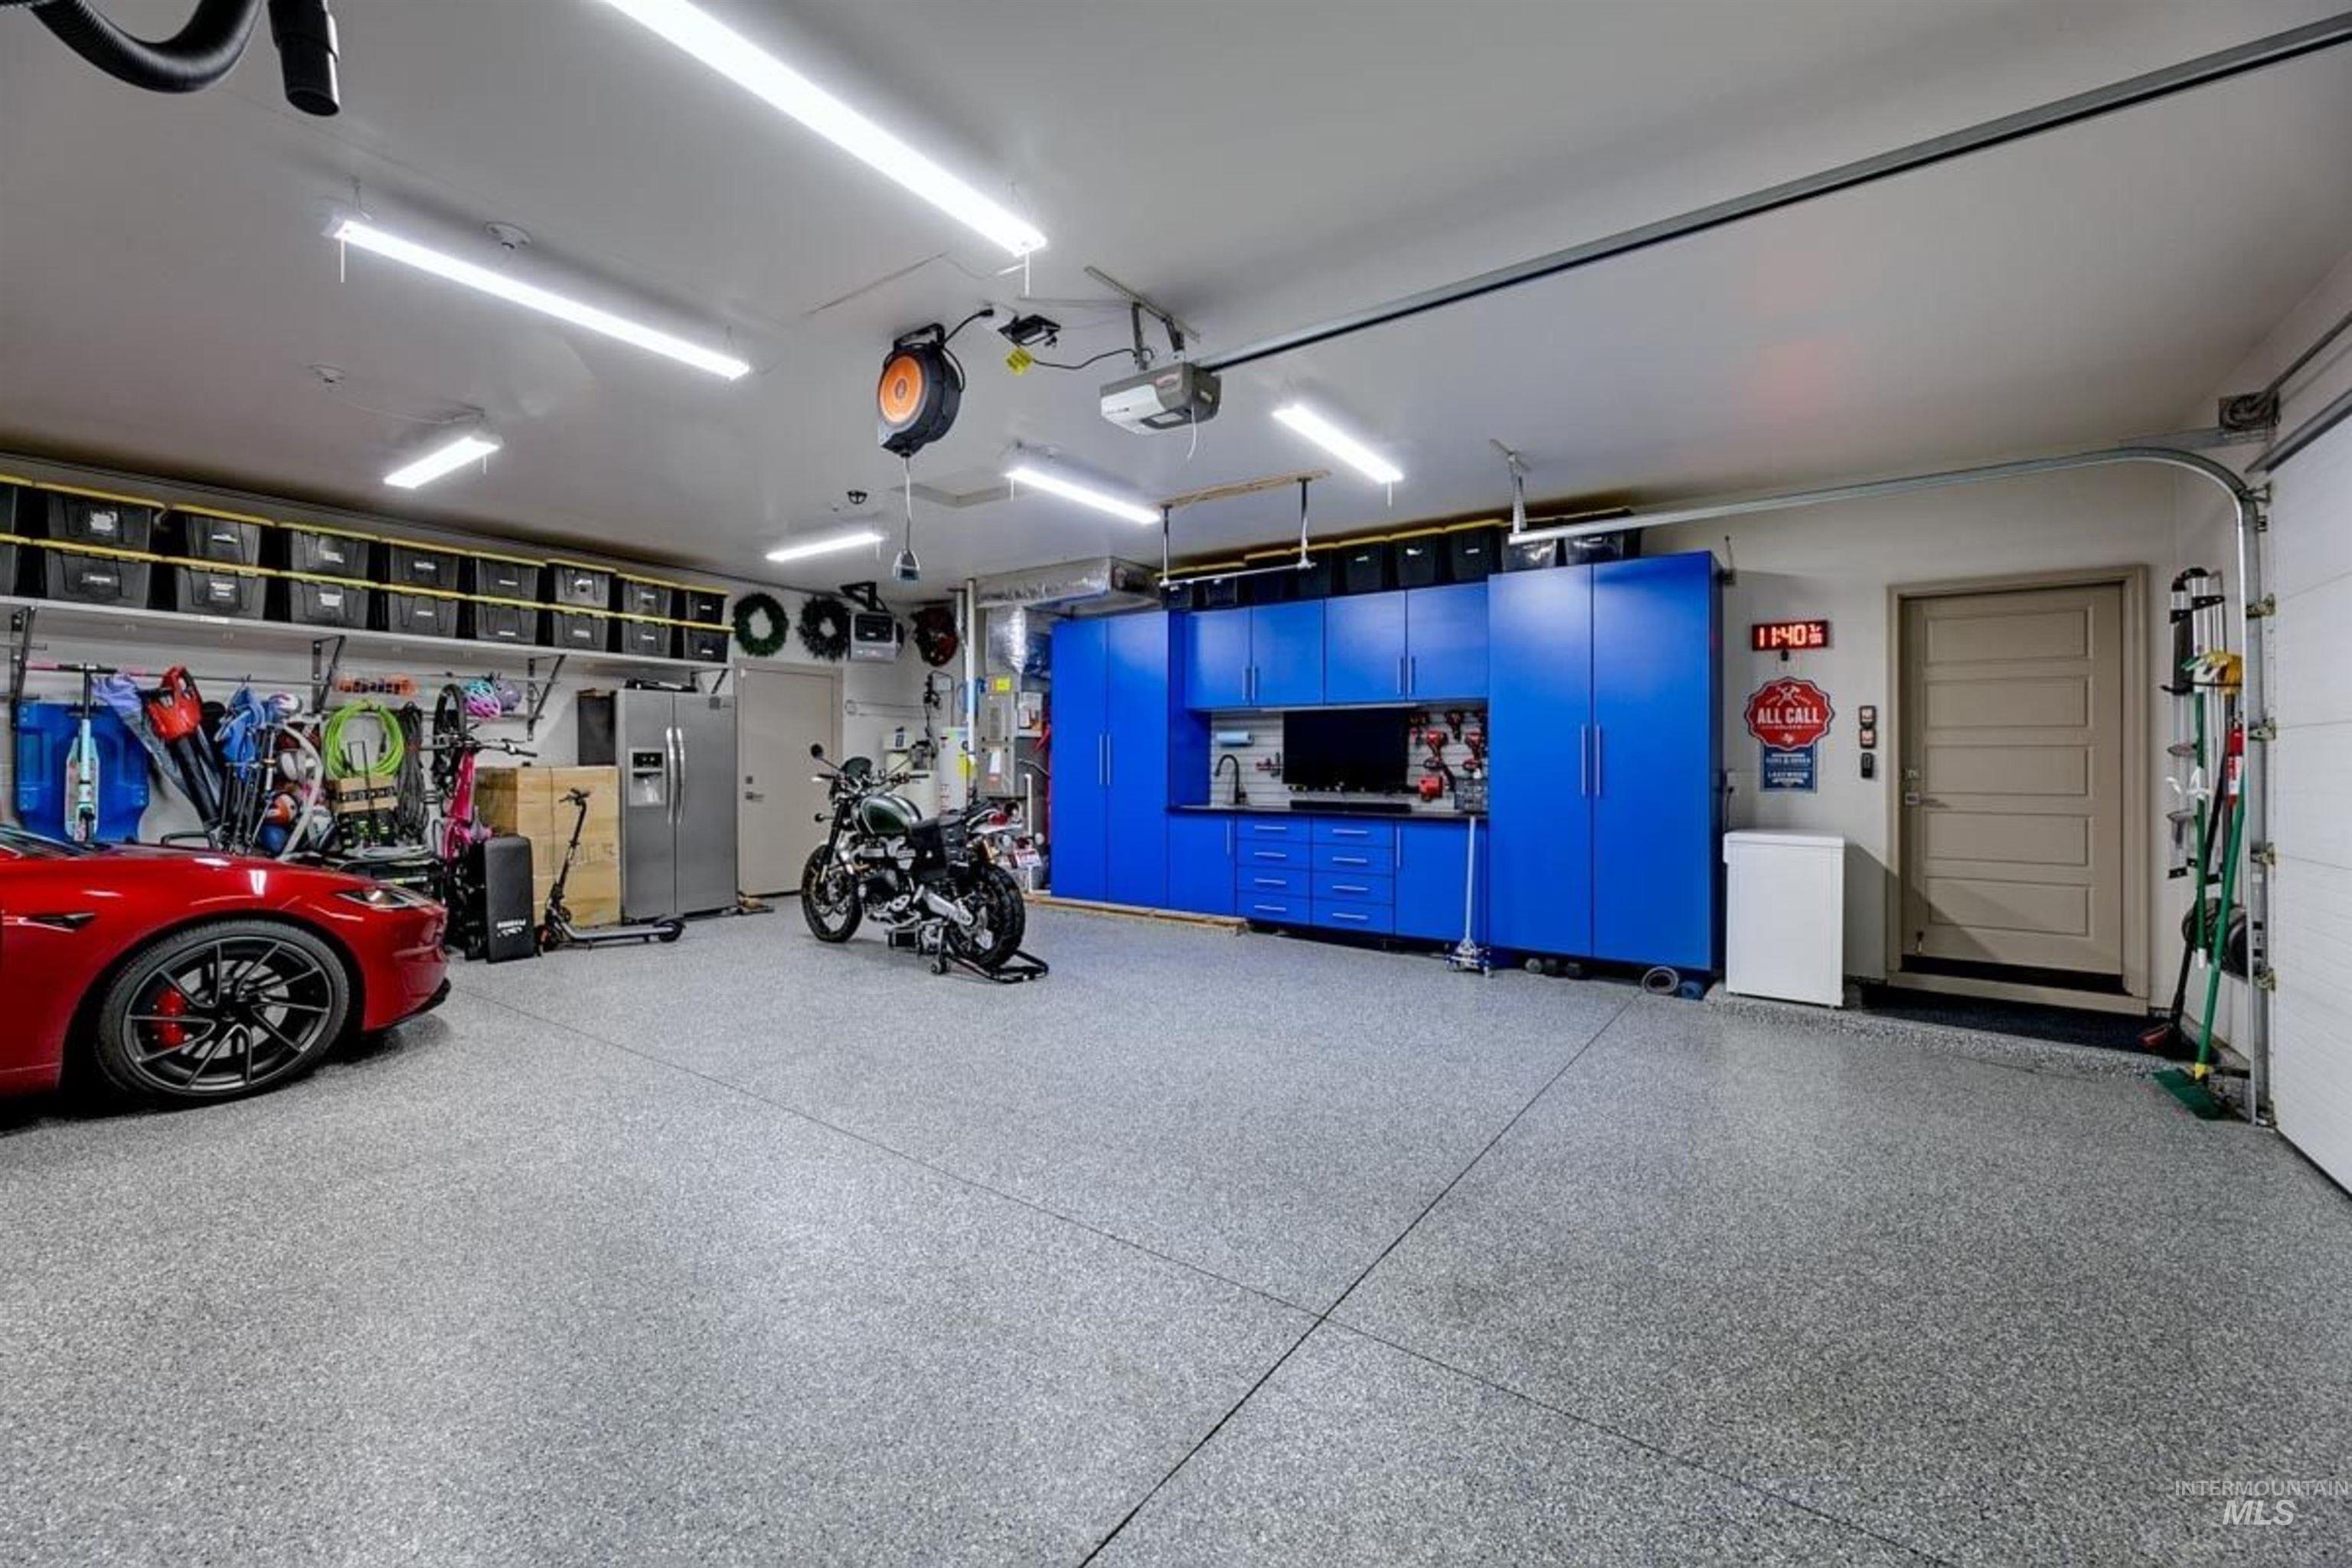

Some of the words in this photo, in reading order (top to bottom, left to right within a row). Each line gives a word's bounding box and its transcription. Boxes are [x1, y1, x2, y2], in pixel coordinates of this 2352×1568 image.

[1759, 625, 1806, 647] 11:40
[1756, 707, 1782, 724] ALL
[1785, 707, 1821, 724] CALL
